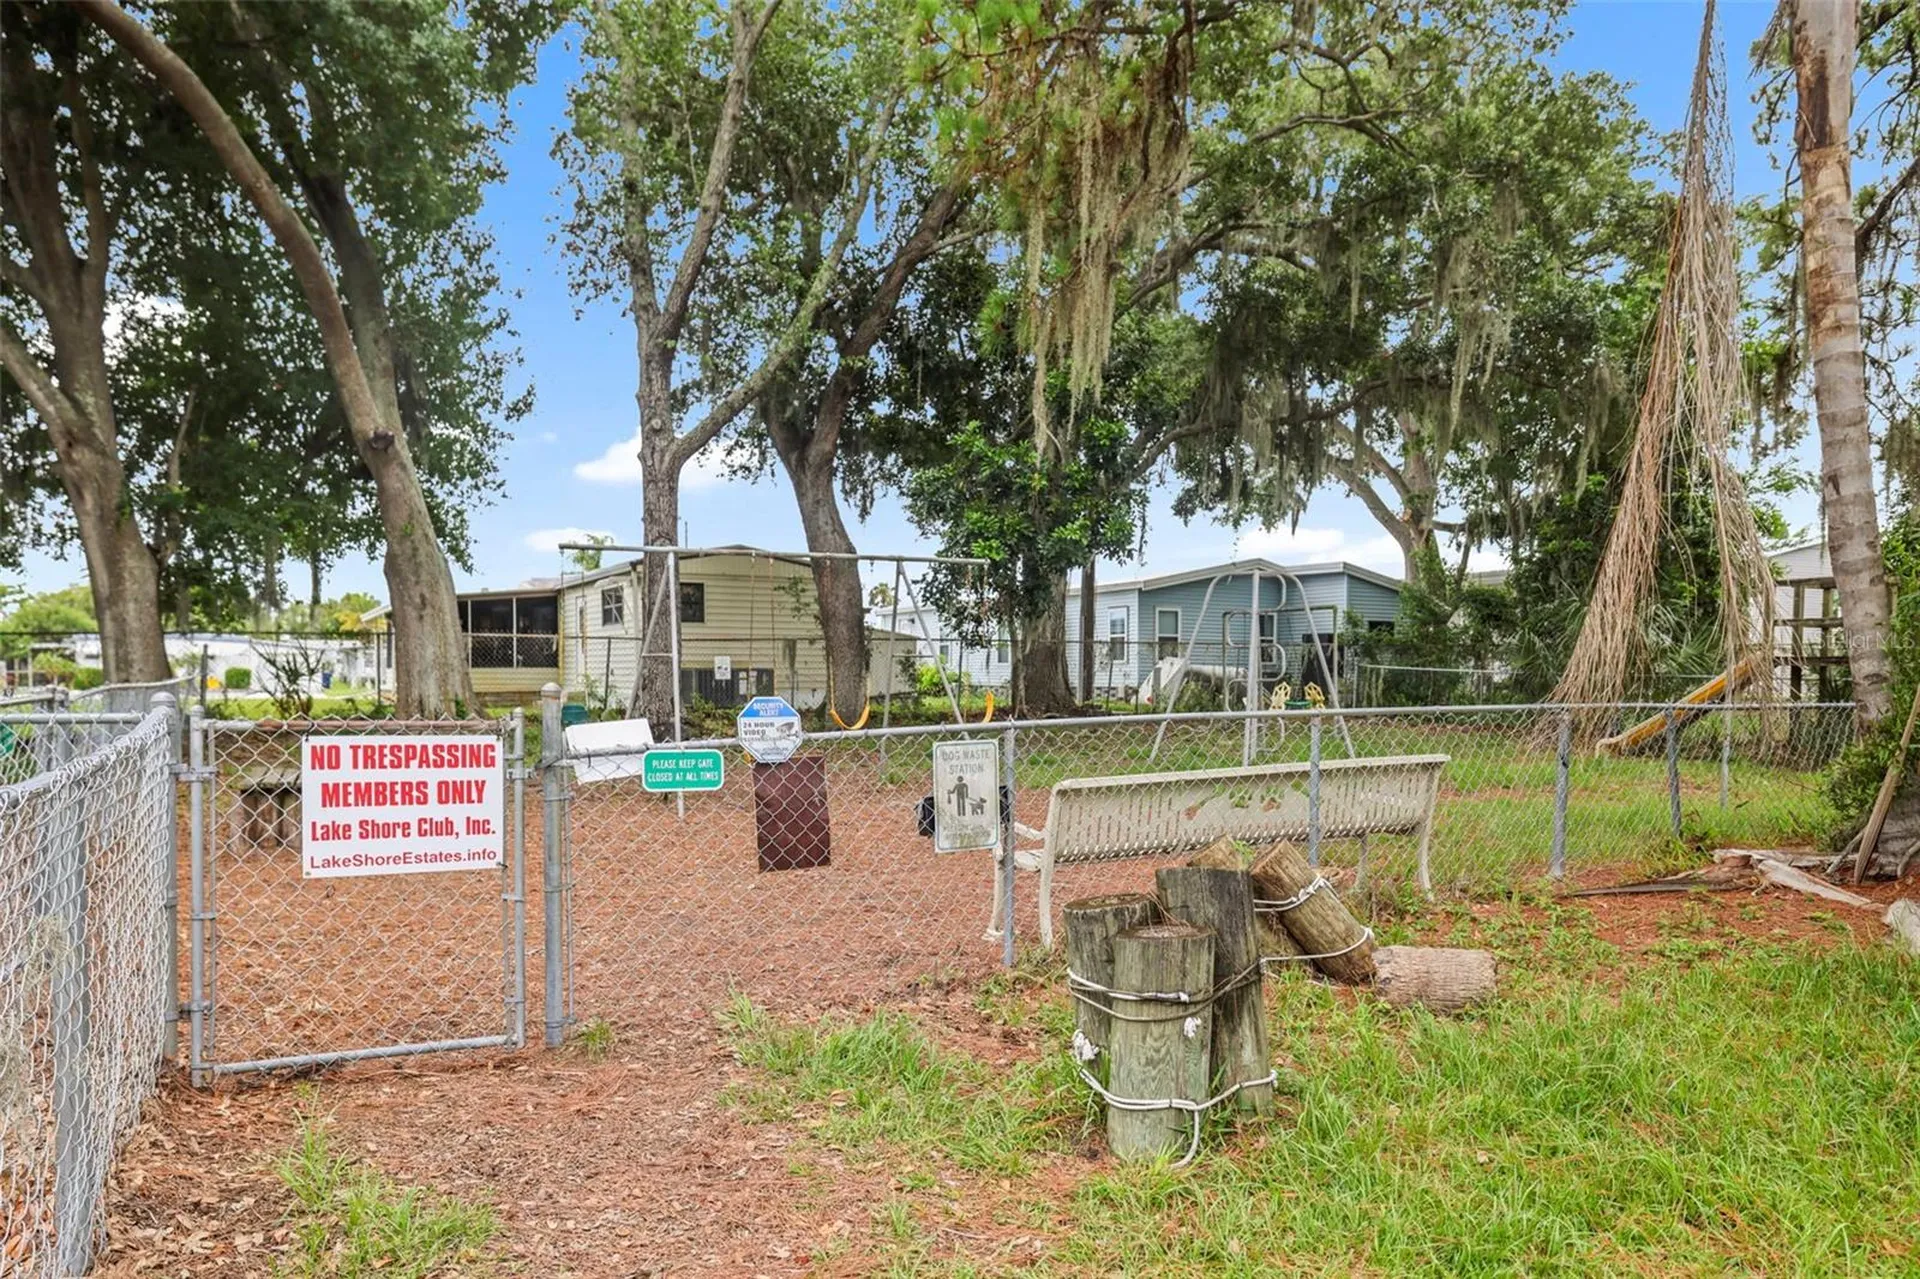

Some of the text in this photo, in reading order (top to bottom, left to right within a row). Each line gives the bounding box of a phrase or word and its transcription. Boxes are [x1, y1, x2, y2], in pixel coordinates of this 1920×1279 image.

[310, 743, 496, 771] NO TRESPASSING
[652, 758, 714, 769] PLEASE KEEP GATE
[942, 749, 991, 761] DOG WASTE
[647, 771, 719, 782] CLOSED AT ALL TIMES
[949, 762, 985, 775] STATION
[321, 779, 487, 808] MEMBERS ONLY
[311, 815, 496, 842] Lake Shore Club, Inc.
[310, 848, 497, 869] LakeShoreEstates.info
